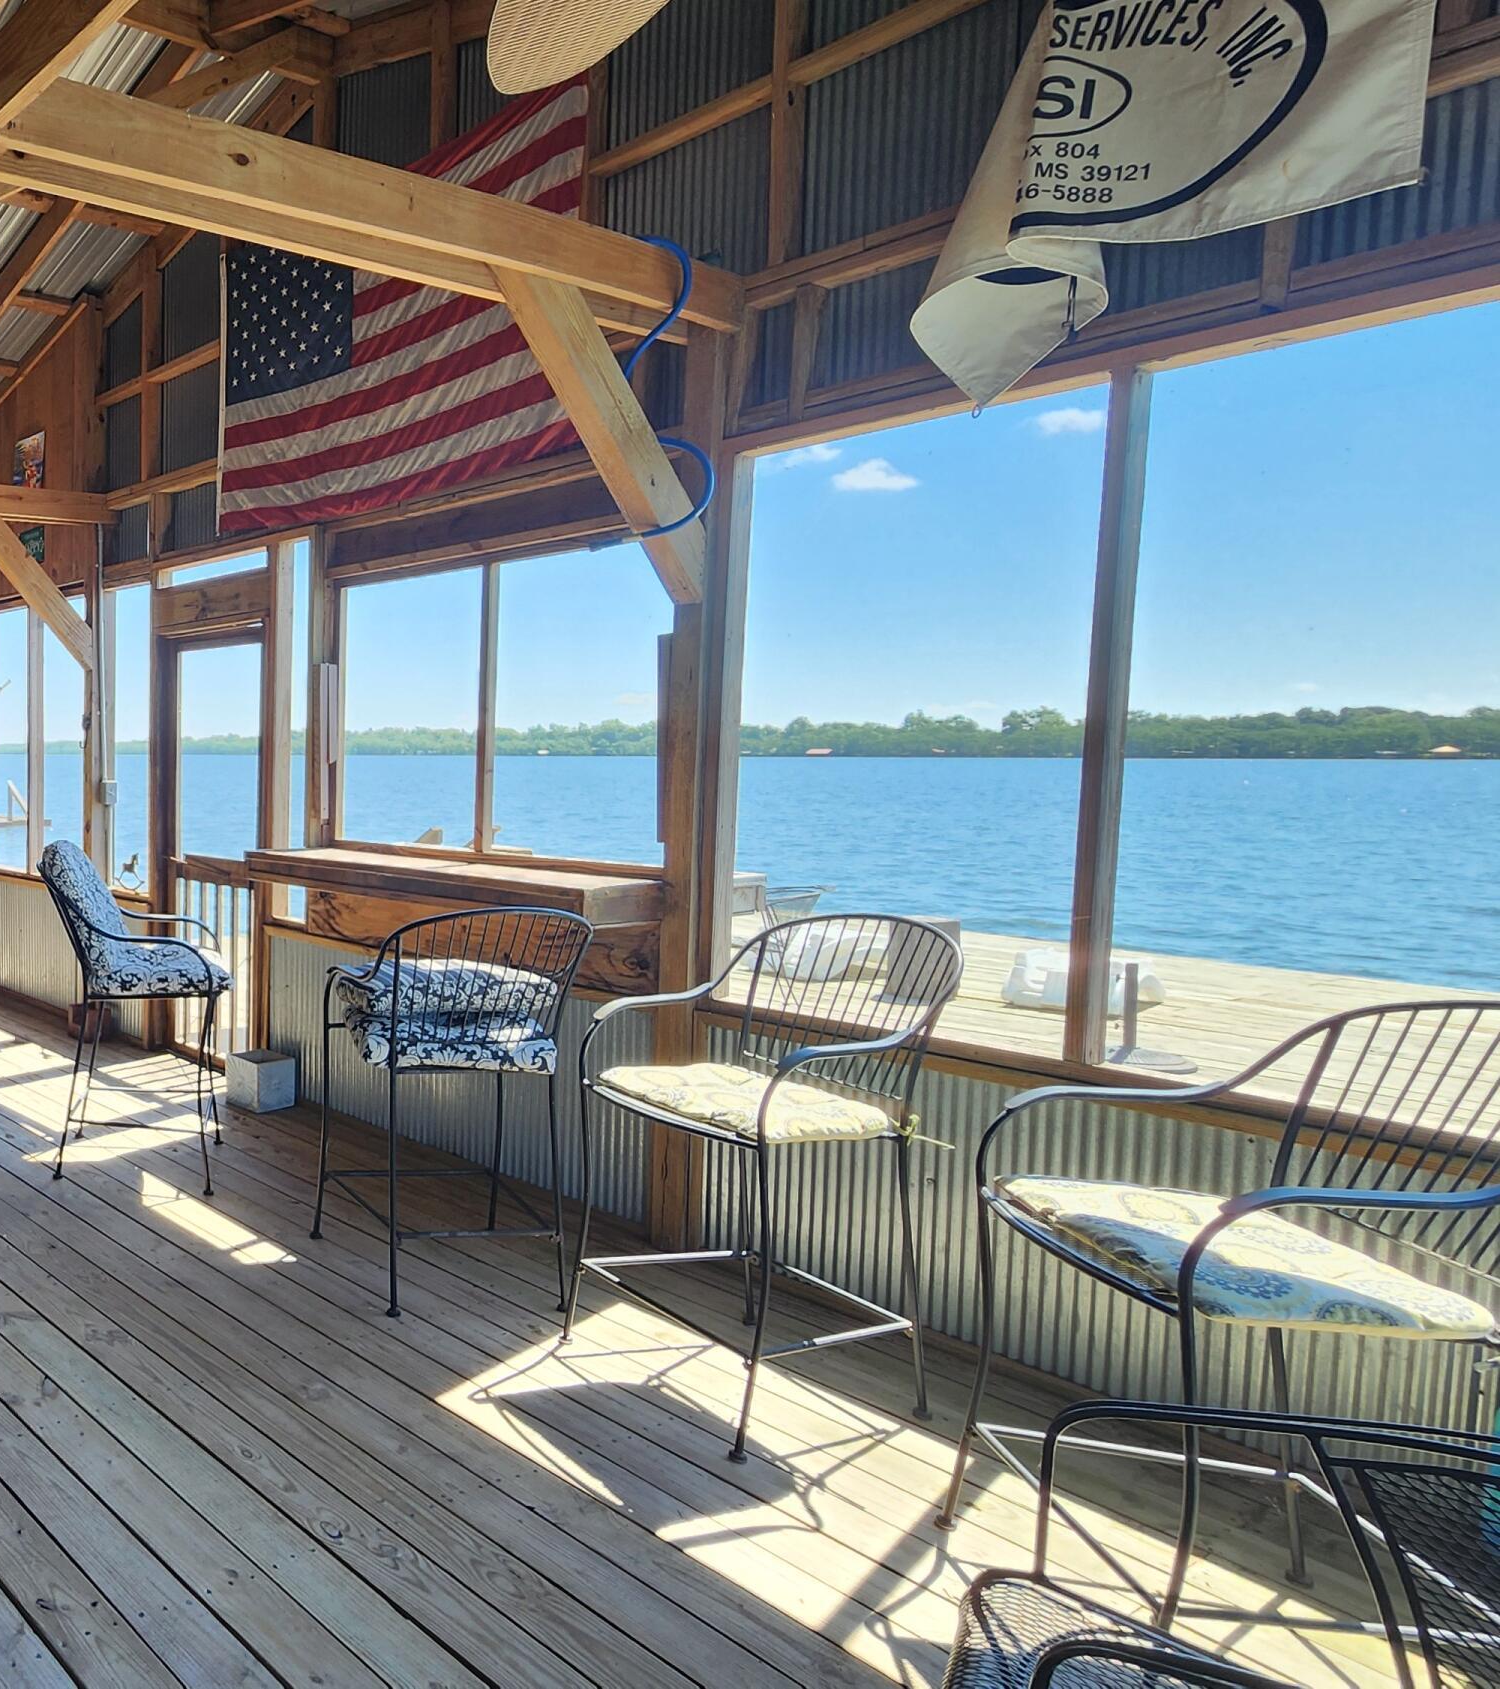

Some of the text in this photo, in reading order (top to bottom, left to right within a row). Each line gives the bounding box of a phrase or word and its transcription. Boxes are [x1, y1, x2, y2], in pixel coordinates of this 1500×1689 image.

[1049, 0, 1293, 87] SERVICES, INC.
[1033, 75, 1096, 120] SI
[1023, 141, 1100, 160] x 804
[1034, 162, 1151, 182] MS 39121
